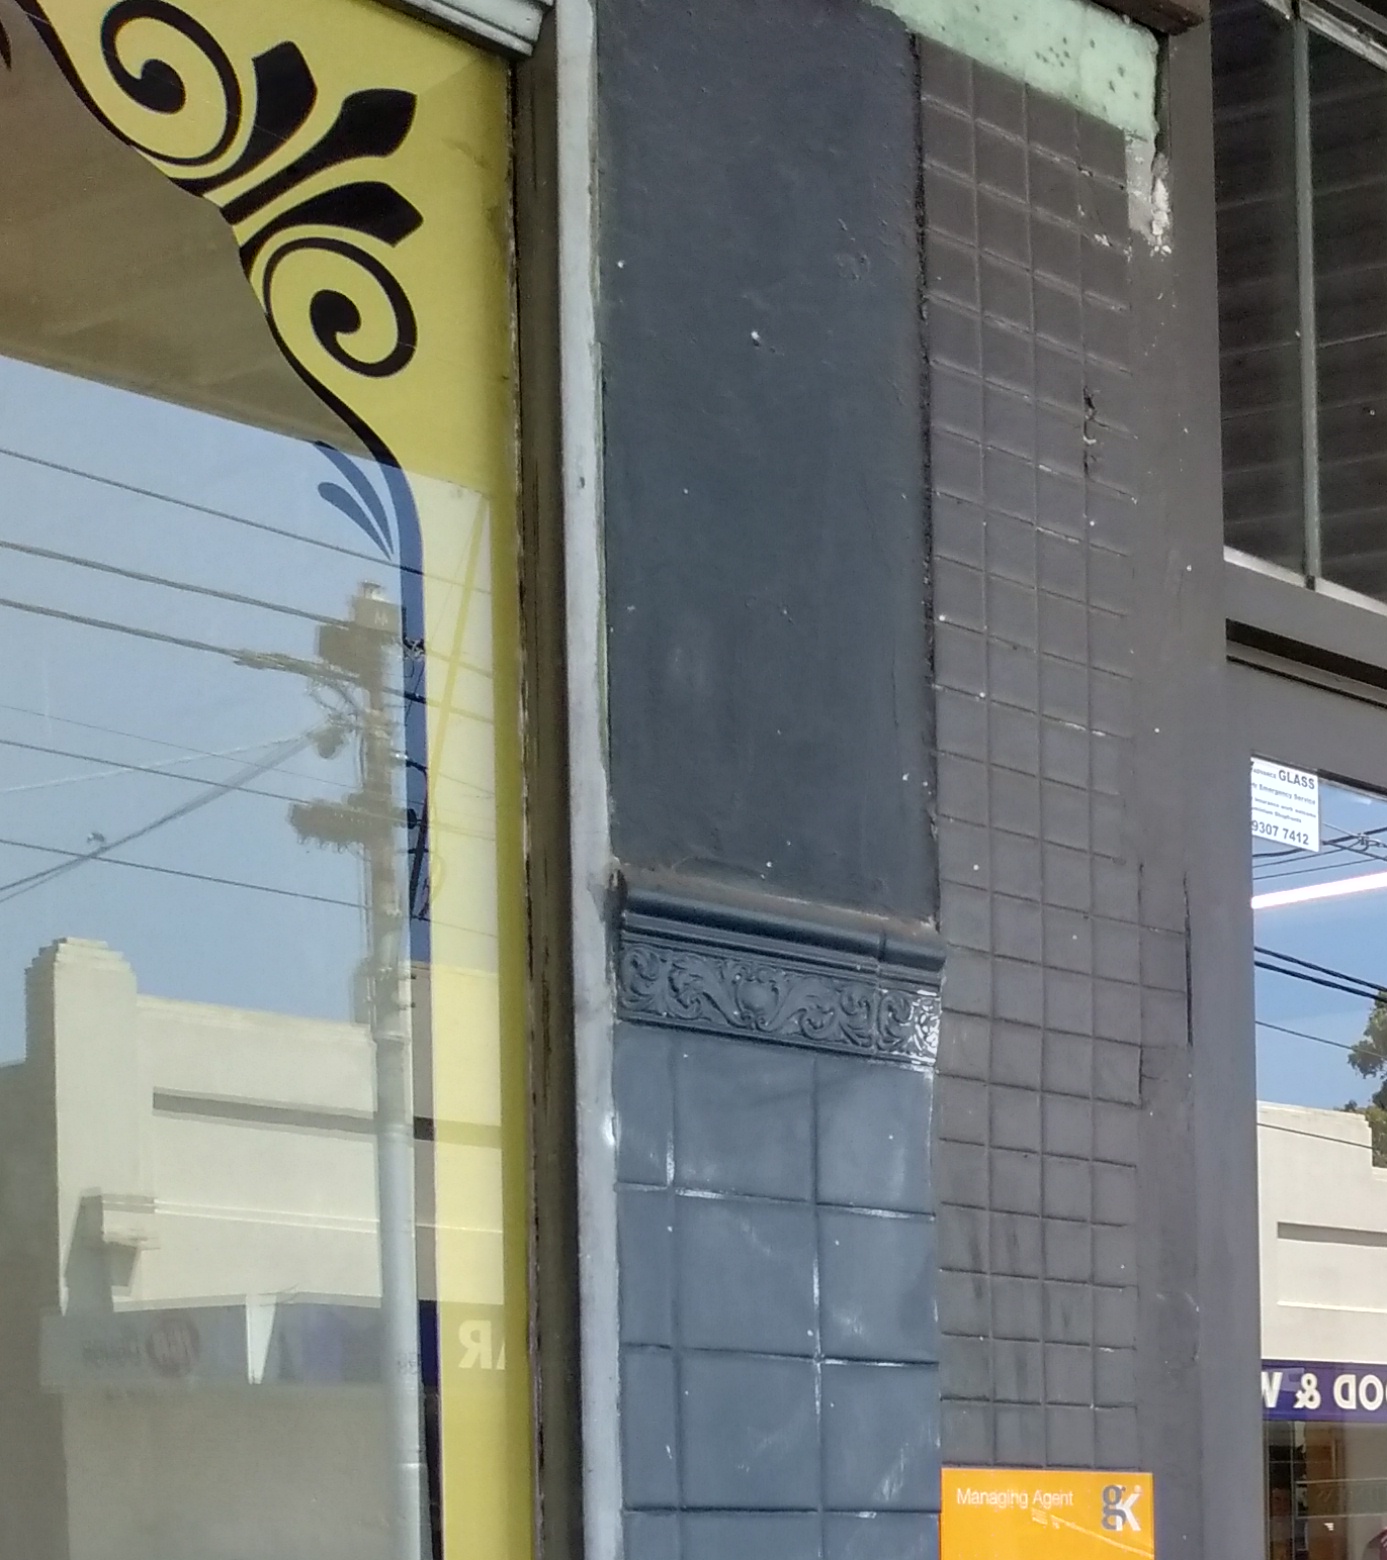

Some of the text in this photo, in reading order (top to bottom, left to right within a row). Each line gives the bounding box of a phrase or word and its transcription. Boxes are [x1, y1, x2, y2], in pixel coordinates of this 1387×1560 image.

[1278, 769, 1316, 790] GLASS
[1251, 819, 1309, 846] 9307 7412
[956, 1488, 1029, 1509] Managing
[1032, 1489, 1074, 1509] Agent
